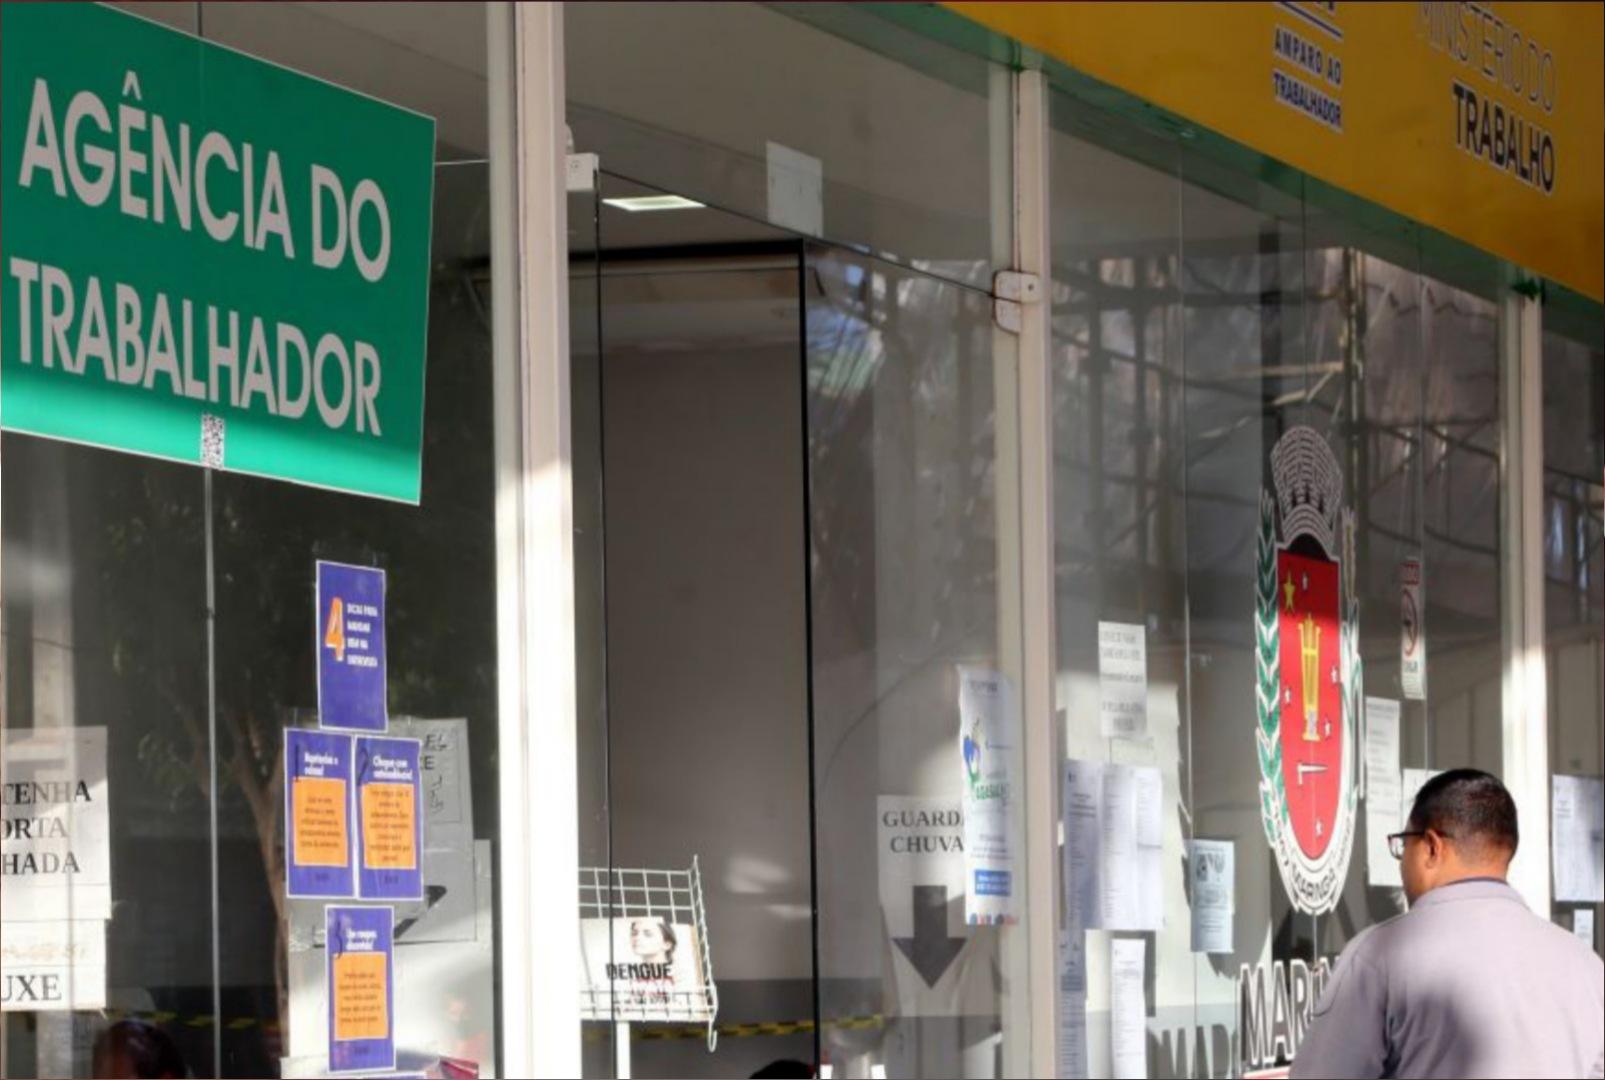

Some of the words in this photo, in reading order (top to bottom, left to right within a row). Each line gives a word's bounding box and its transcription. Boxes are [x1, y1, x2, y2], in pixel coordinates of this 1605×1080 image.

[1274, 27, 1322, 74] AMPARO
[1327, 56, 1342, 86] AO
[1273, 71, 1342, 128] TRABALHADOR
[1453, 82, 1556, 193] TRABALHO
[18, 69, 296, 260] AGÊNCIA
[310, 162, 392, 283] DO
[9, 255, 383, 438] TRABALHADOR
[325, 597, 345, 662] 4
[882, 810, 965, 828] GUARD
[890, 835, 964, 853] CHUVA
[606, 961, 674, 981] DENGUE
